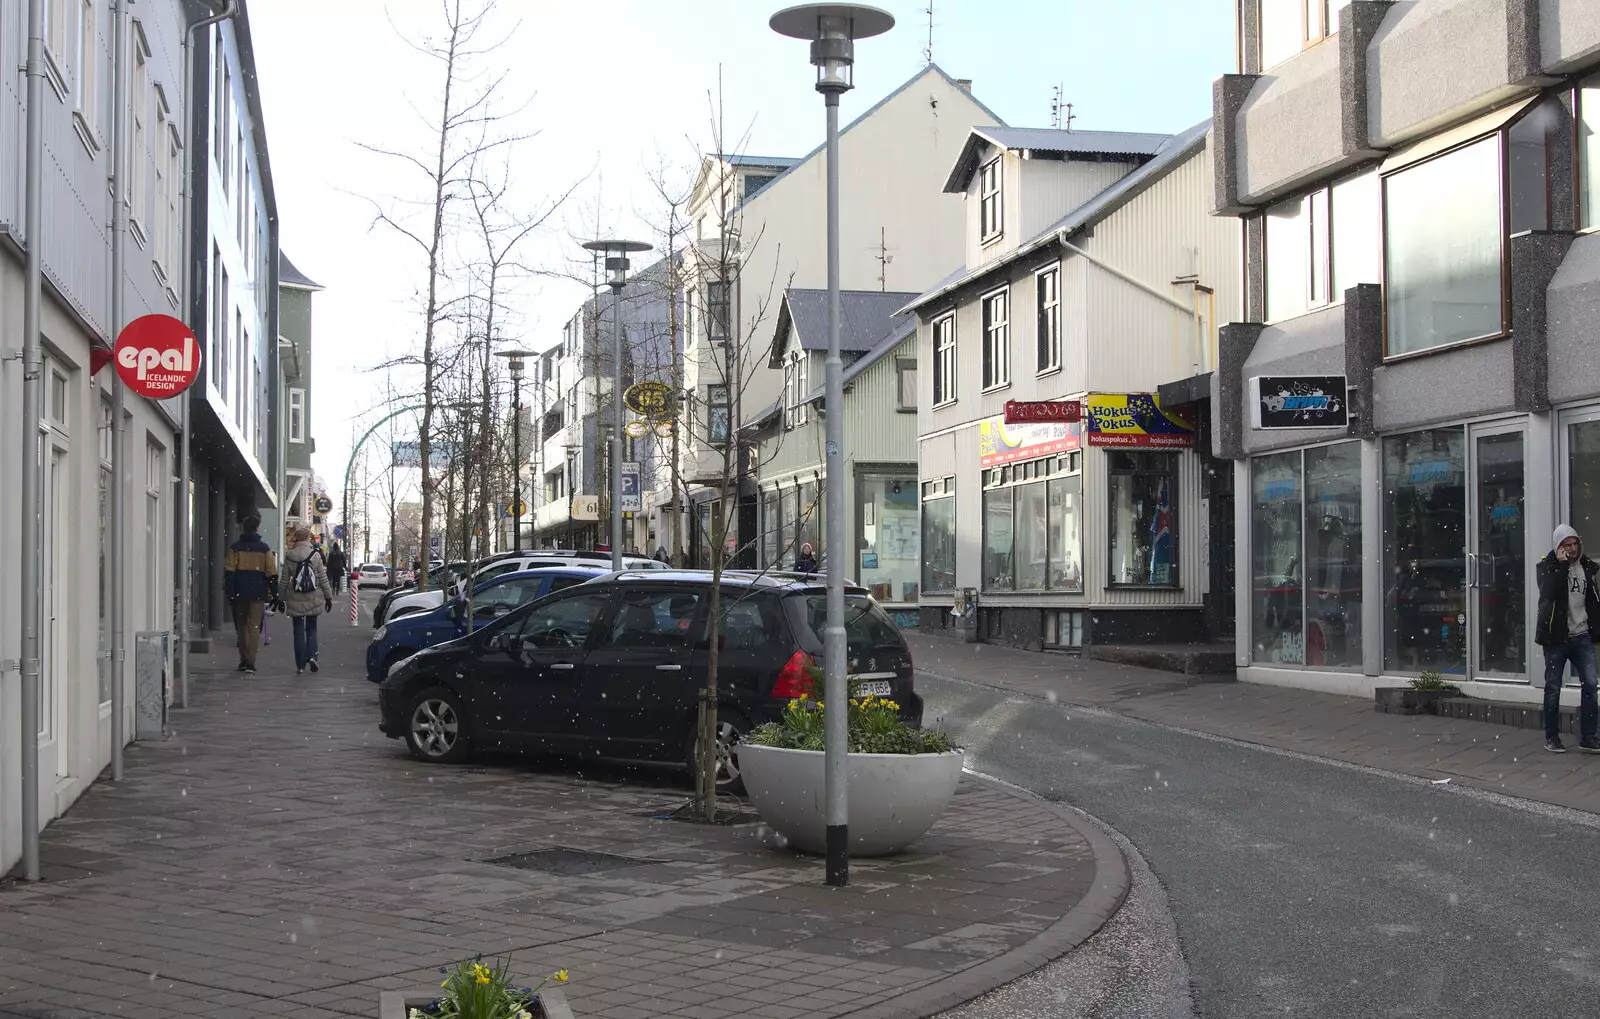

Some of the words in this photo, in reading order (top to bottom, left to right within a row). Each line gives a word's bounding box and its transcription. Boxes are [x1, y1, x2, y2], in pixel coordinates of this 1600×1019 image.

[118, 338, 193, 380] epal
[147, 374, 186, 383] ICELANDIC
[146, 382, 175, 390] DESIGN
[1008, 403, 1058, 417] TATTOO
[1061, 403, 1077, 416] 69
[1092, 406, 1137, 417] Hokus
[1093, 417, 1136, 430] Pokus
[1091, 436, 1137, 444] hokuspokus.is
[875, 681, 890, 695] 658
